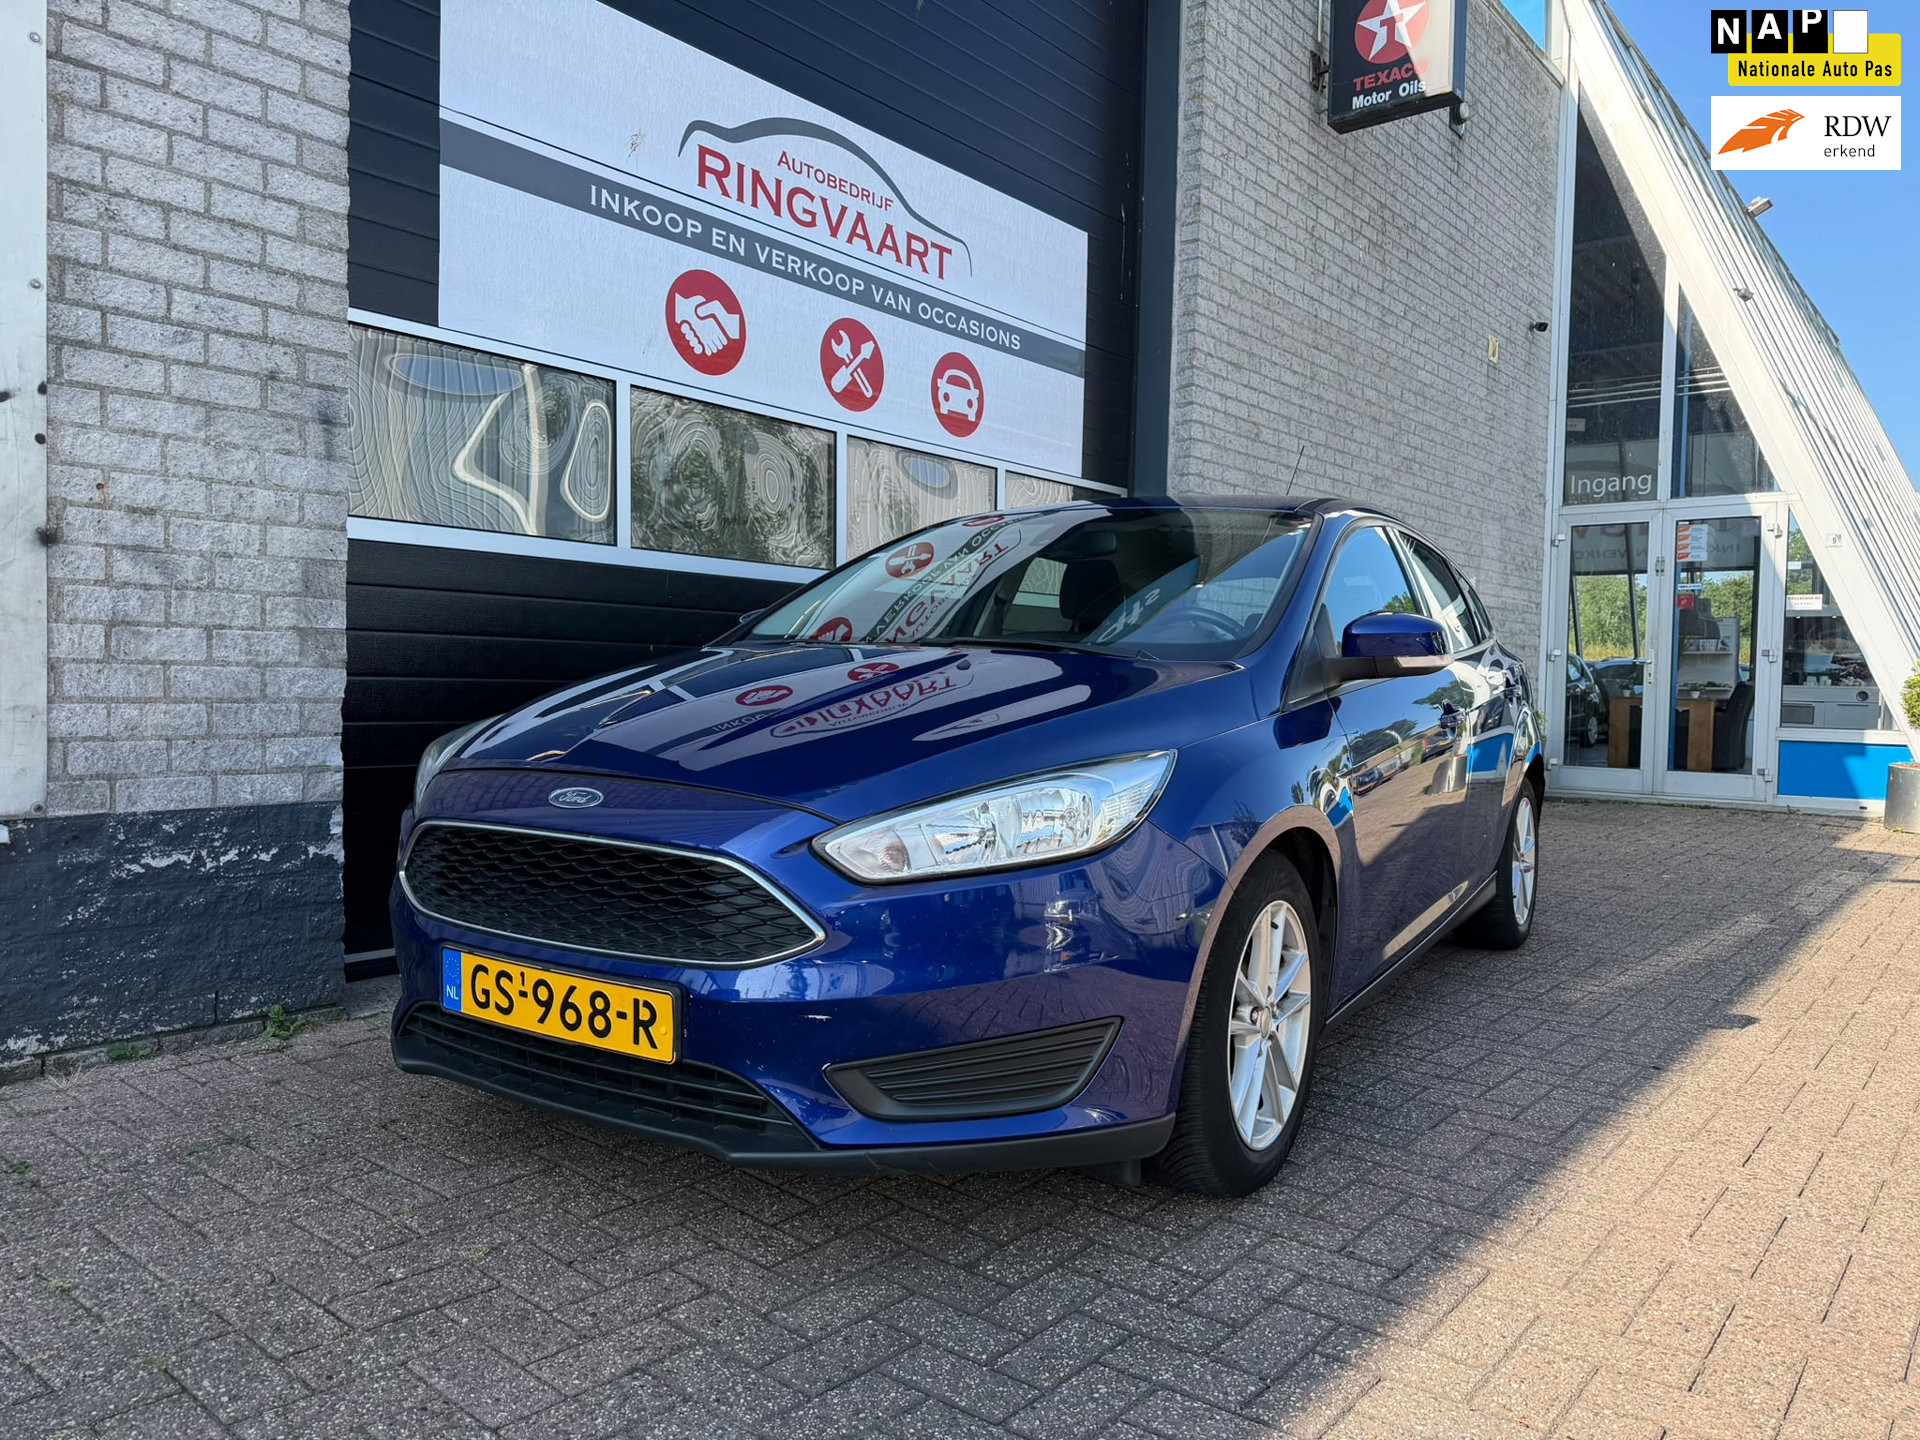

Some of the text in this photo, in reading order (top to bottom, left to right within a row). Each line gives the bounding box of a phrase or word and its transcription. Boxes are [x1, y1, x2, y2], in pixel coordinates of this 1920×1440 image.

[1353, 59, 1429, 92] TEXACO
[1352, 80, 1427, 110] Motor Oils
[777, 151, 894, 211] AUTOBEDRIJF
[697, 144, 953, 280] RINGVAART
[590, 184, 1022, 351] INKOOP EN VERKOOP VAN OCCASIONS
[1570, 473, 1653, 498] Ingang
[558, 789, 592, 804] Ford
[446, 984, 459, 1000] NL
